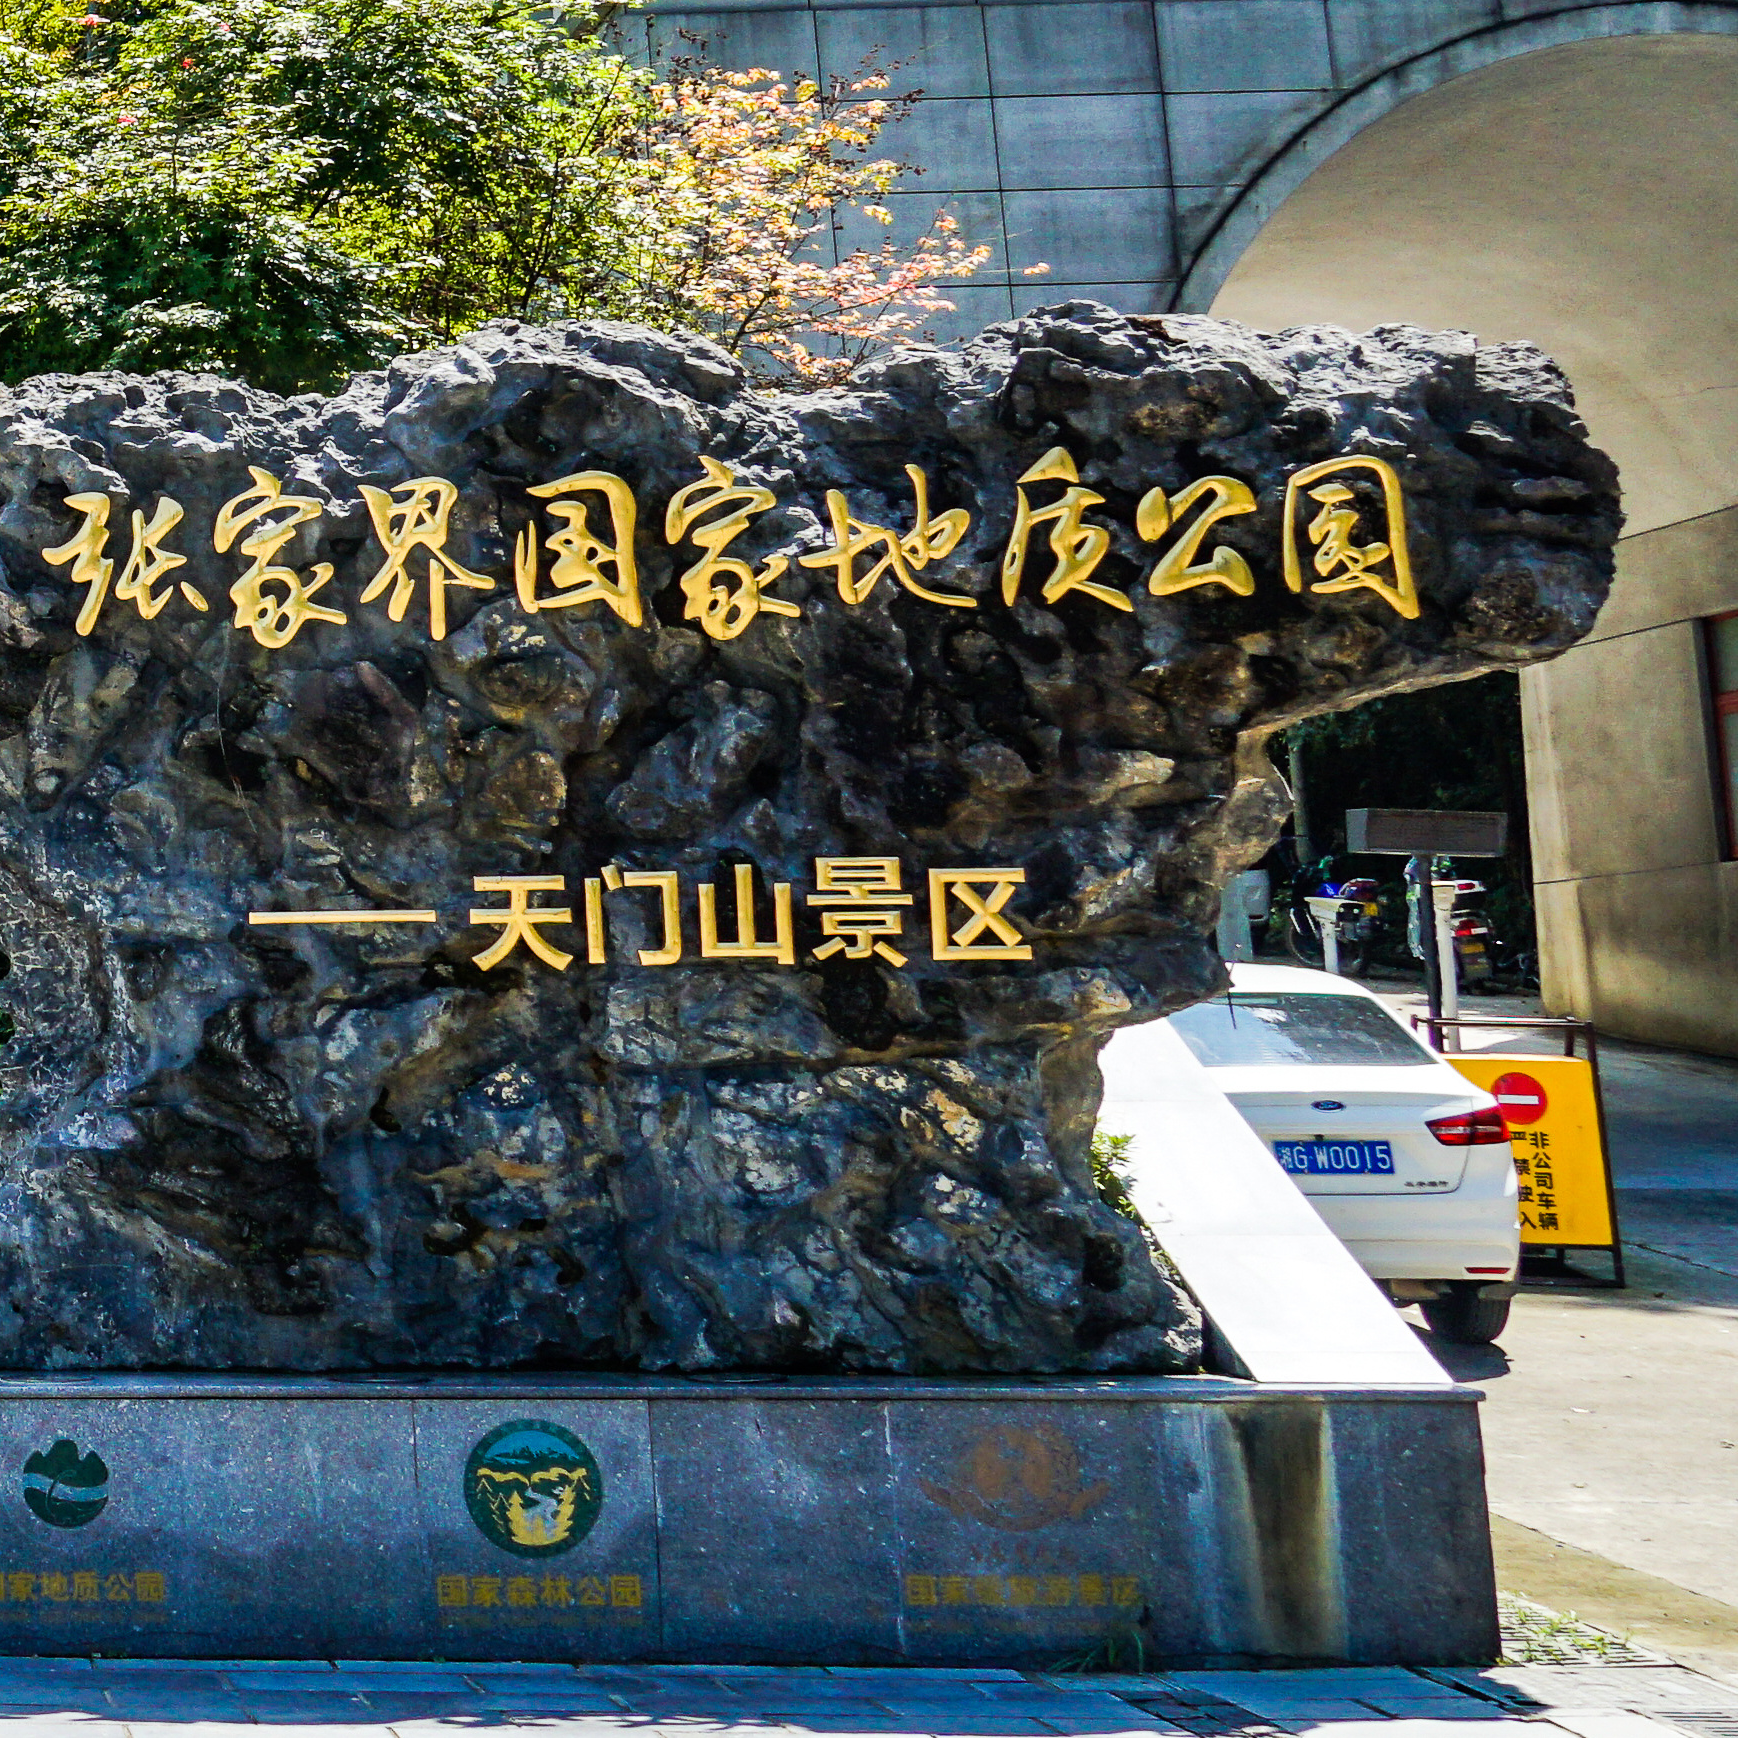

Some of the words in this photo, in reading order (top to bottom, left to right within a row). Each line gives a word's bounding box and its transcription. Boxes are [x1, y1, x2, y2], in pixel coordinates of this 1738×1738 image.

[40, 445, 1420, 650] 张家界国家地质公园
[1528, 1130, 1559, 1231] 非公司车辆
[436, 1573, 643, 1608] 国家森林公园
